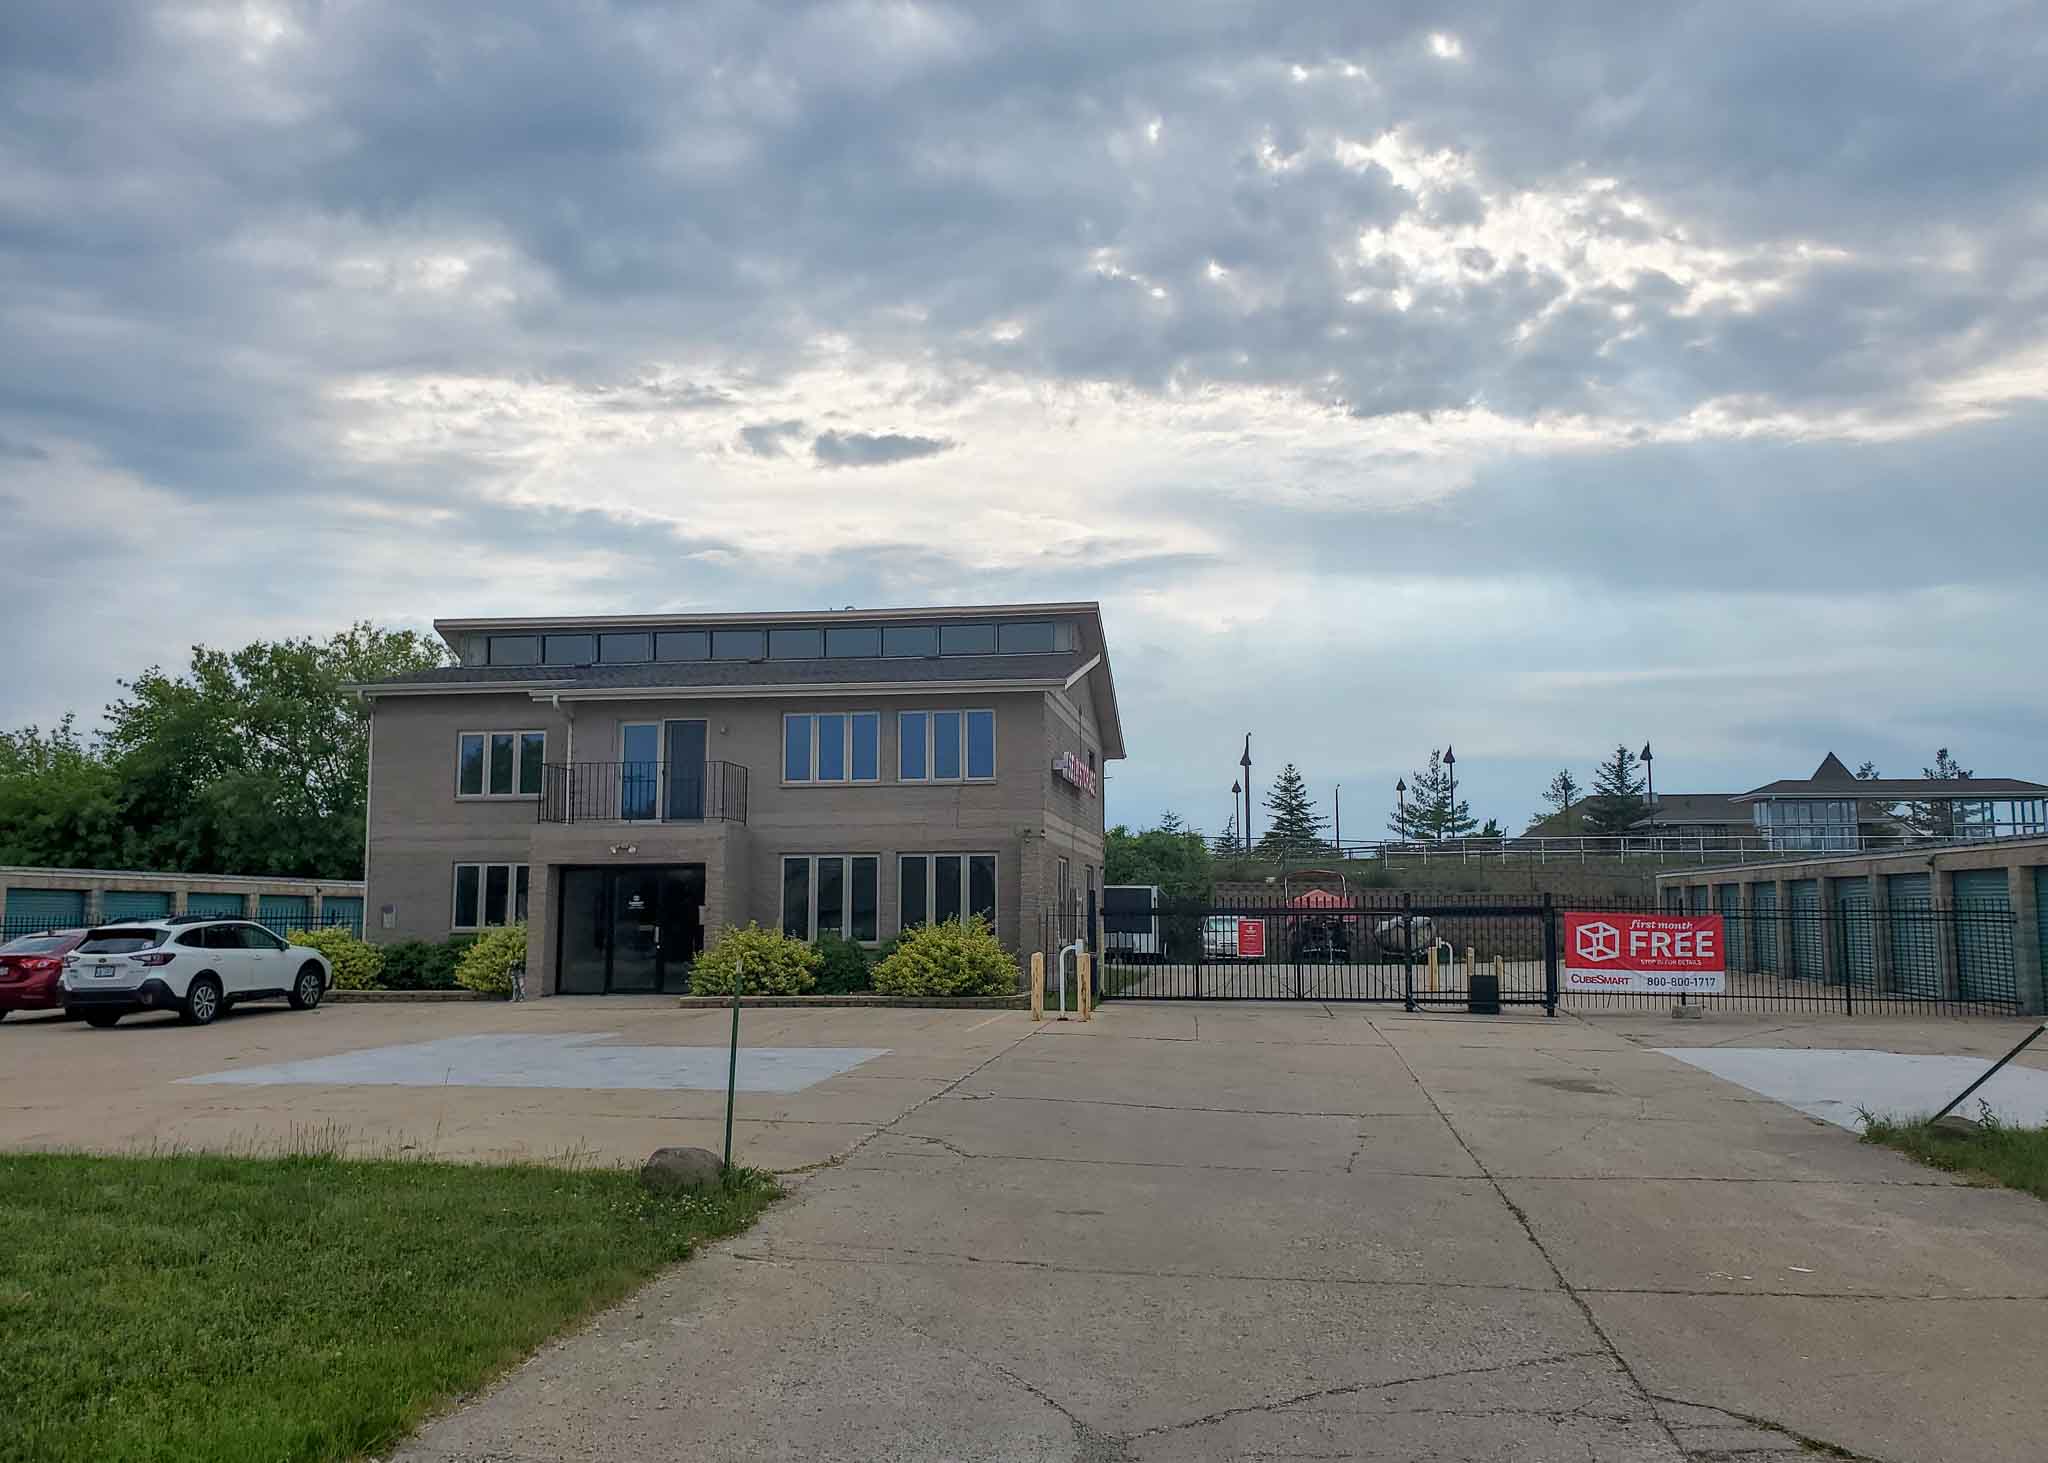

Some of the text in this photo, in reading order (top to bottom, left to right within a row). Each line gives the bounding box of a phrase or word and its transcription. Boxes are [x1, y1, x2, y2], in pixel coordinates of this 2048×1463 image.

[1630, 919, 1693, 930] first month
[1630, 930, 1714, 957] FREE
[1647, 977, 1715, 987] 800-800-1717
